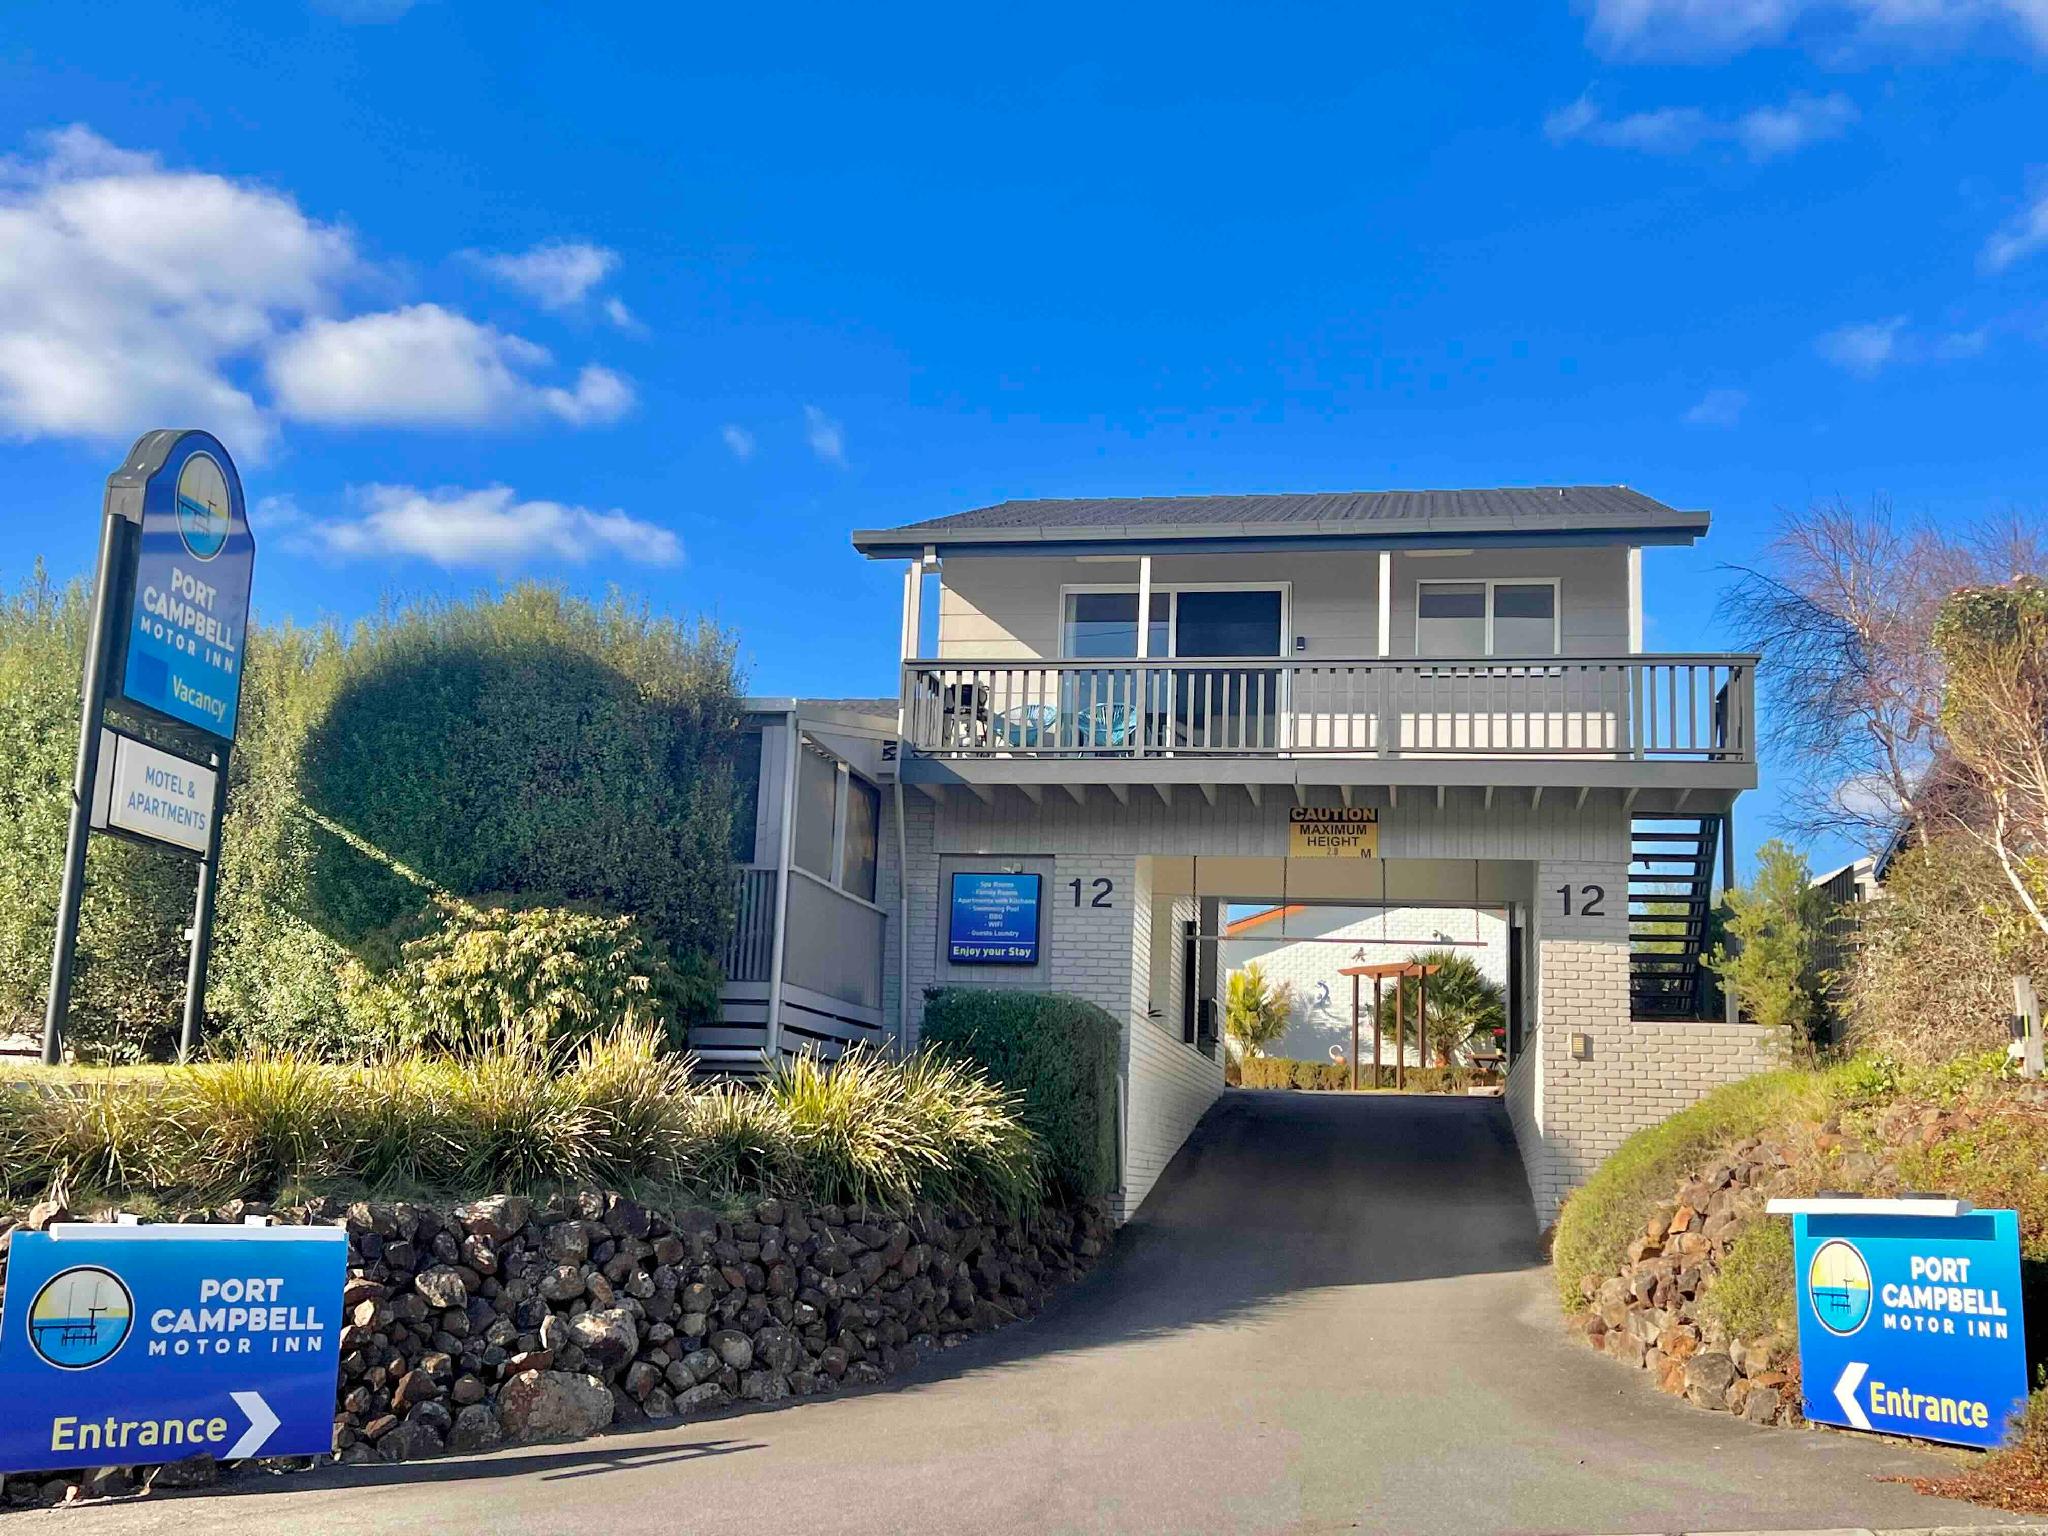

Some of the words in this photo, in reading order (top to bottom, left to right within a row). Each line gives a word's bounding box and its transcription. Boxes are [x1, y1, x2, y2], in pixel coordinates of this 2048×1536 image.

[171, 567, 217, 612] PORT
[143, 586, 235, 652] CAMPBELL
[140, 616, 195, 656] MOTOR
[206, 648, 233, 674] INN
[173, 674, 227, 722] Vacancy
[145, 766, 184, 795] MOTEL
[187, 781, 196, 799] &
[128, 791, 206, 830] APARTMENTS
[1291, 808, 1376, 820] CAUTION
[1300, 824, 1367, 835] MAXIMUM
[1307, 836, 1360, 847] HEIGHT
[1360, 848, 1372, 859] M
[1069, 878, 1113, 908] 12
[1557, 884, 1605, 916] 12
[953, 946, 981, 957] Enjoy
[983, 947, 1007, 957] your
[1008, 946, 1031, 958] Stay
[1910, 1256, 1971, 1283] PORT
[200, 1278, 284, 1303] PORT
[1882, 1283, 2007, 1317] CAMPBELL
[150, 1306, 324, 1334] CAMPBELL
[1884, 1314, 1955, 1335] MOTOR
[1968, 1321, 2008, 1339] INN
[148, 1338, 251, 1357] MOTOR
[271, 1336, 323, 1353] INN
[1870, 1381, 1989, 1429] Entrance
[51, 1416, 228, 1451] Entrance
